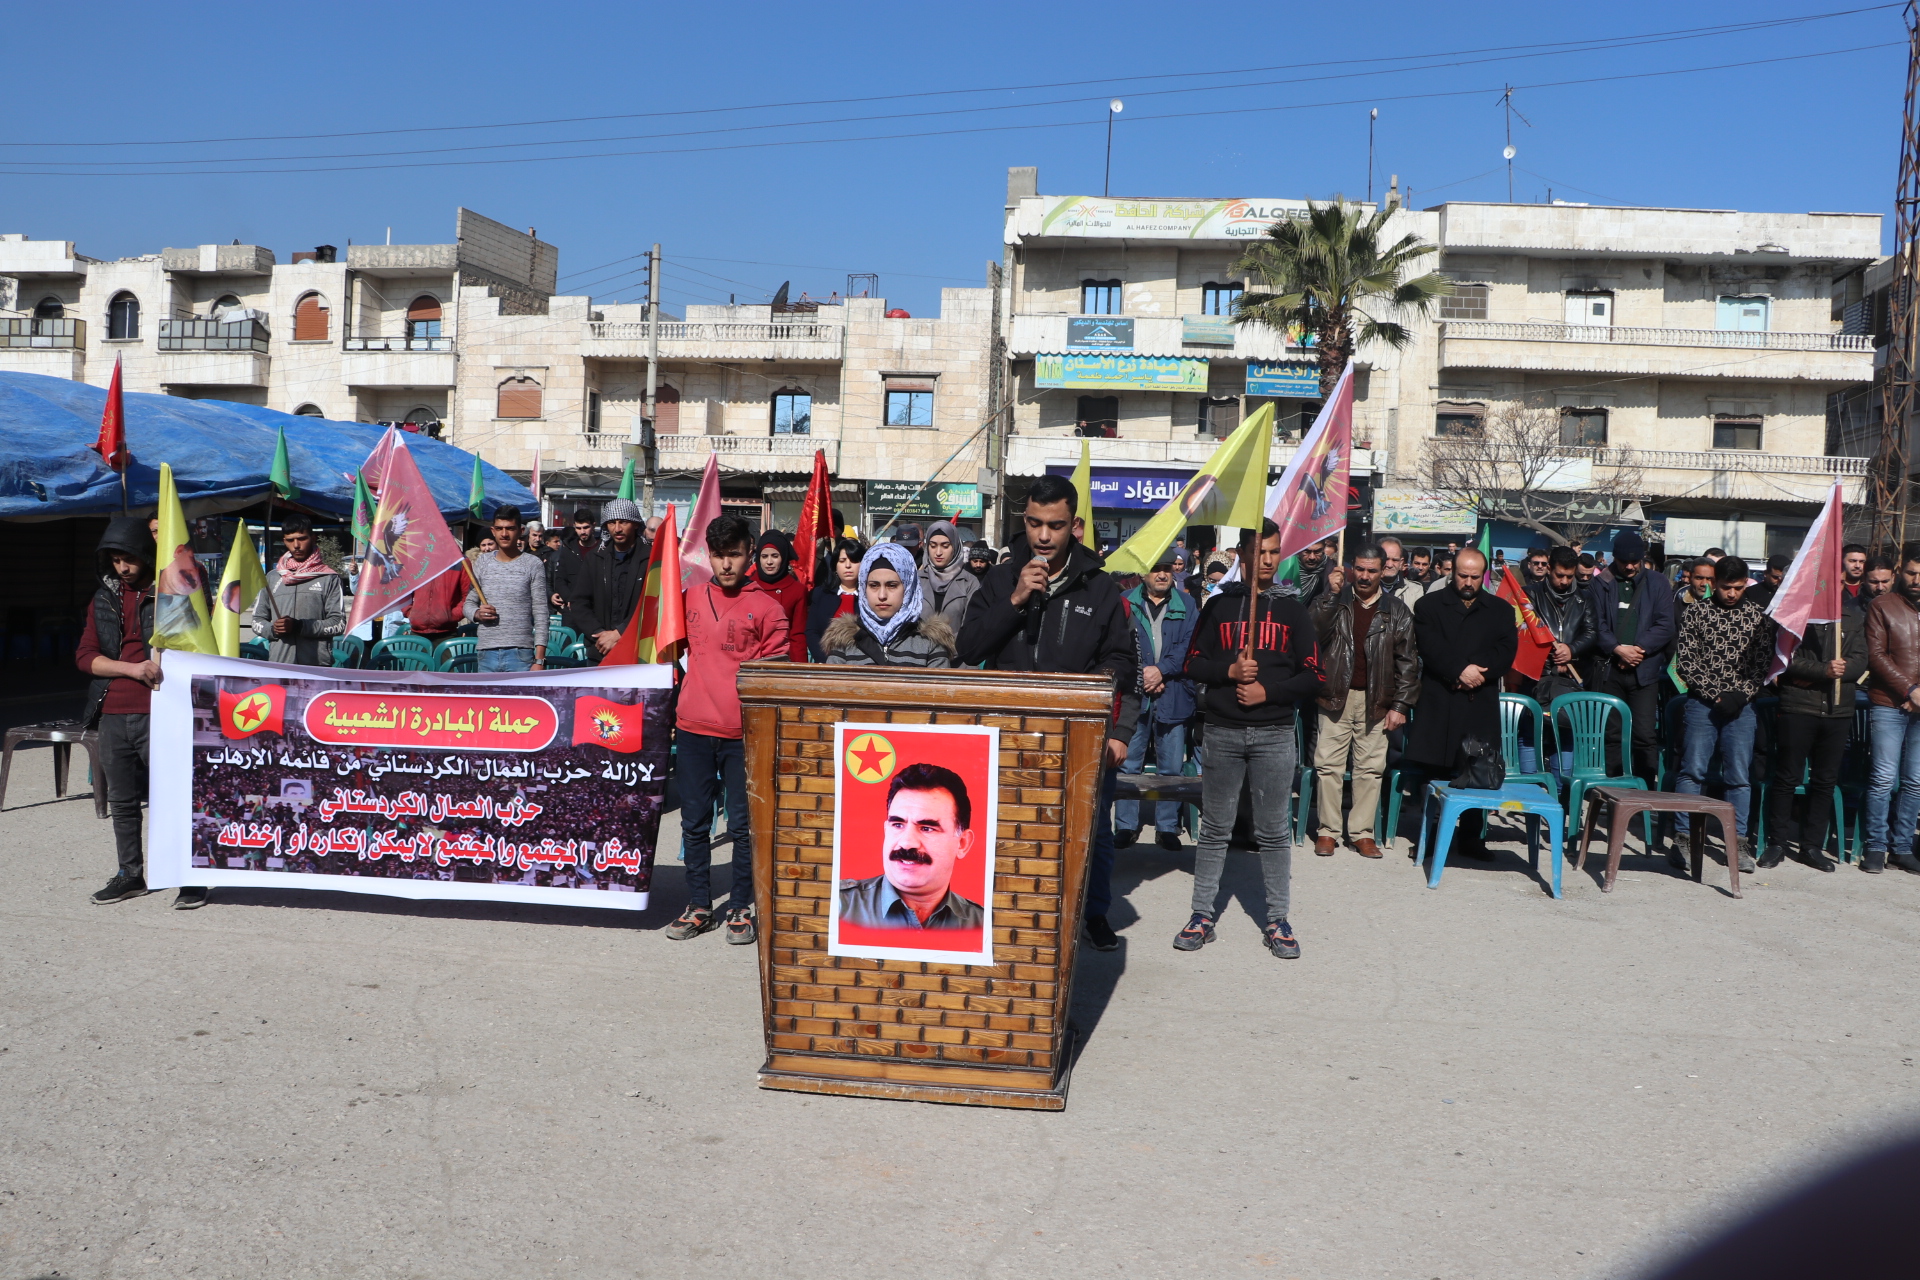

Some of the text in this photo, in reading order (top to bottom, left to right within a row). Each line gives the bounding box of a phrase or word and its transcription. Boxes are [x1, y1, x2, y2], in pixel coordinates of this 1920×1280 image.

[1115, 203, 1205, 220] شركة الحافظ
[1229, 207, 1323, 218] BALQEE
[1225, 227, 1257, 236] التجارية
[1130, 373, 1153, 383] ياسر
[1139, 360, 1179, 373] عيادة
[1090, 480, 1179, 503] الفؤاد للحوالا
[324, 700, 540, 738] حملة المبادرة الشعبية
[206, 746, 272, 770] الإرهاب
[336, 754, 361, 775] من
[368, 755, 469, 781] الكردستاني
[477, 758, 535, 781] العمال
[543, 760, 592, 784] حزب
[601, 760, 655, 786] لازالة
[319, 787, 543, 827] حزب العمال الكردستاني
[218, 822, 282, 856] إخفائه
[285, 823, 307, 856] أو
[308, 827, 367, 860] إنكاره
[435, 832, 516, 866] والمجتمع
[517, 838, 587, 872] المجتمع
[594, 837, 641, 875] يمثل
